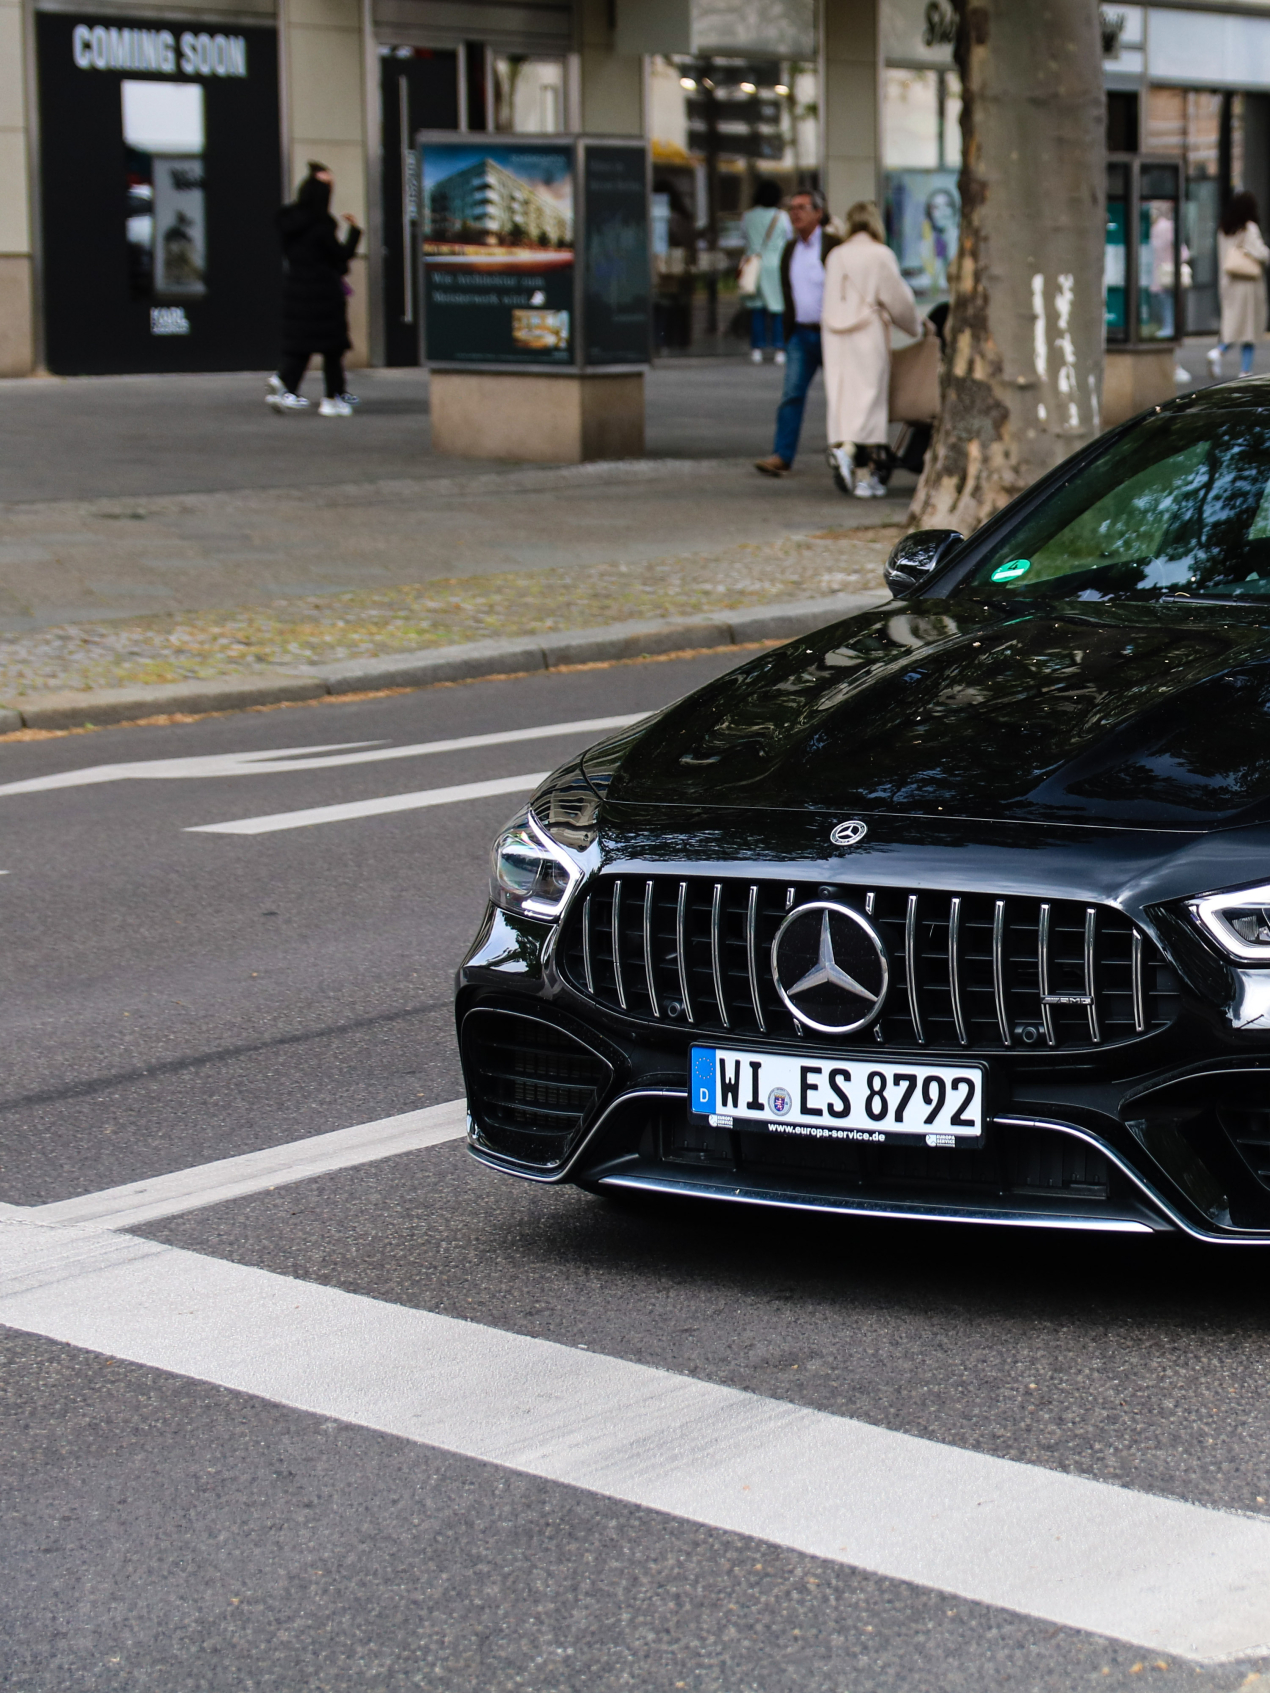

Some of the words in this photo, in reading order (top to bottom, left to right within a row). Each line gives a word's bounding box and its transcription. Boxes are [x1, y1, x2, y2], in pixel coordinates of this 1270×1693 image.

[73, 23, 176, 73] COMING
[180, 31, 247, 77] SOON
[1008, 560, 1019, 570] 4
[699, 1088, 709, 1103] D
[718, 1056, 765, 1112] WI
[799, 1065, 852, 1120] ES
[864, 1069, 976, 1128] 8792
[768, 1122, 886, 1142] www.europa-service.de
